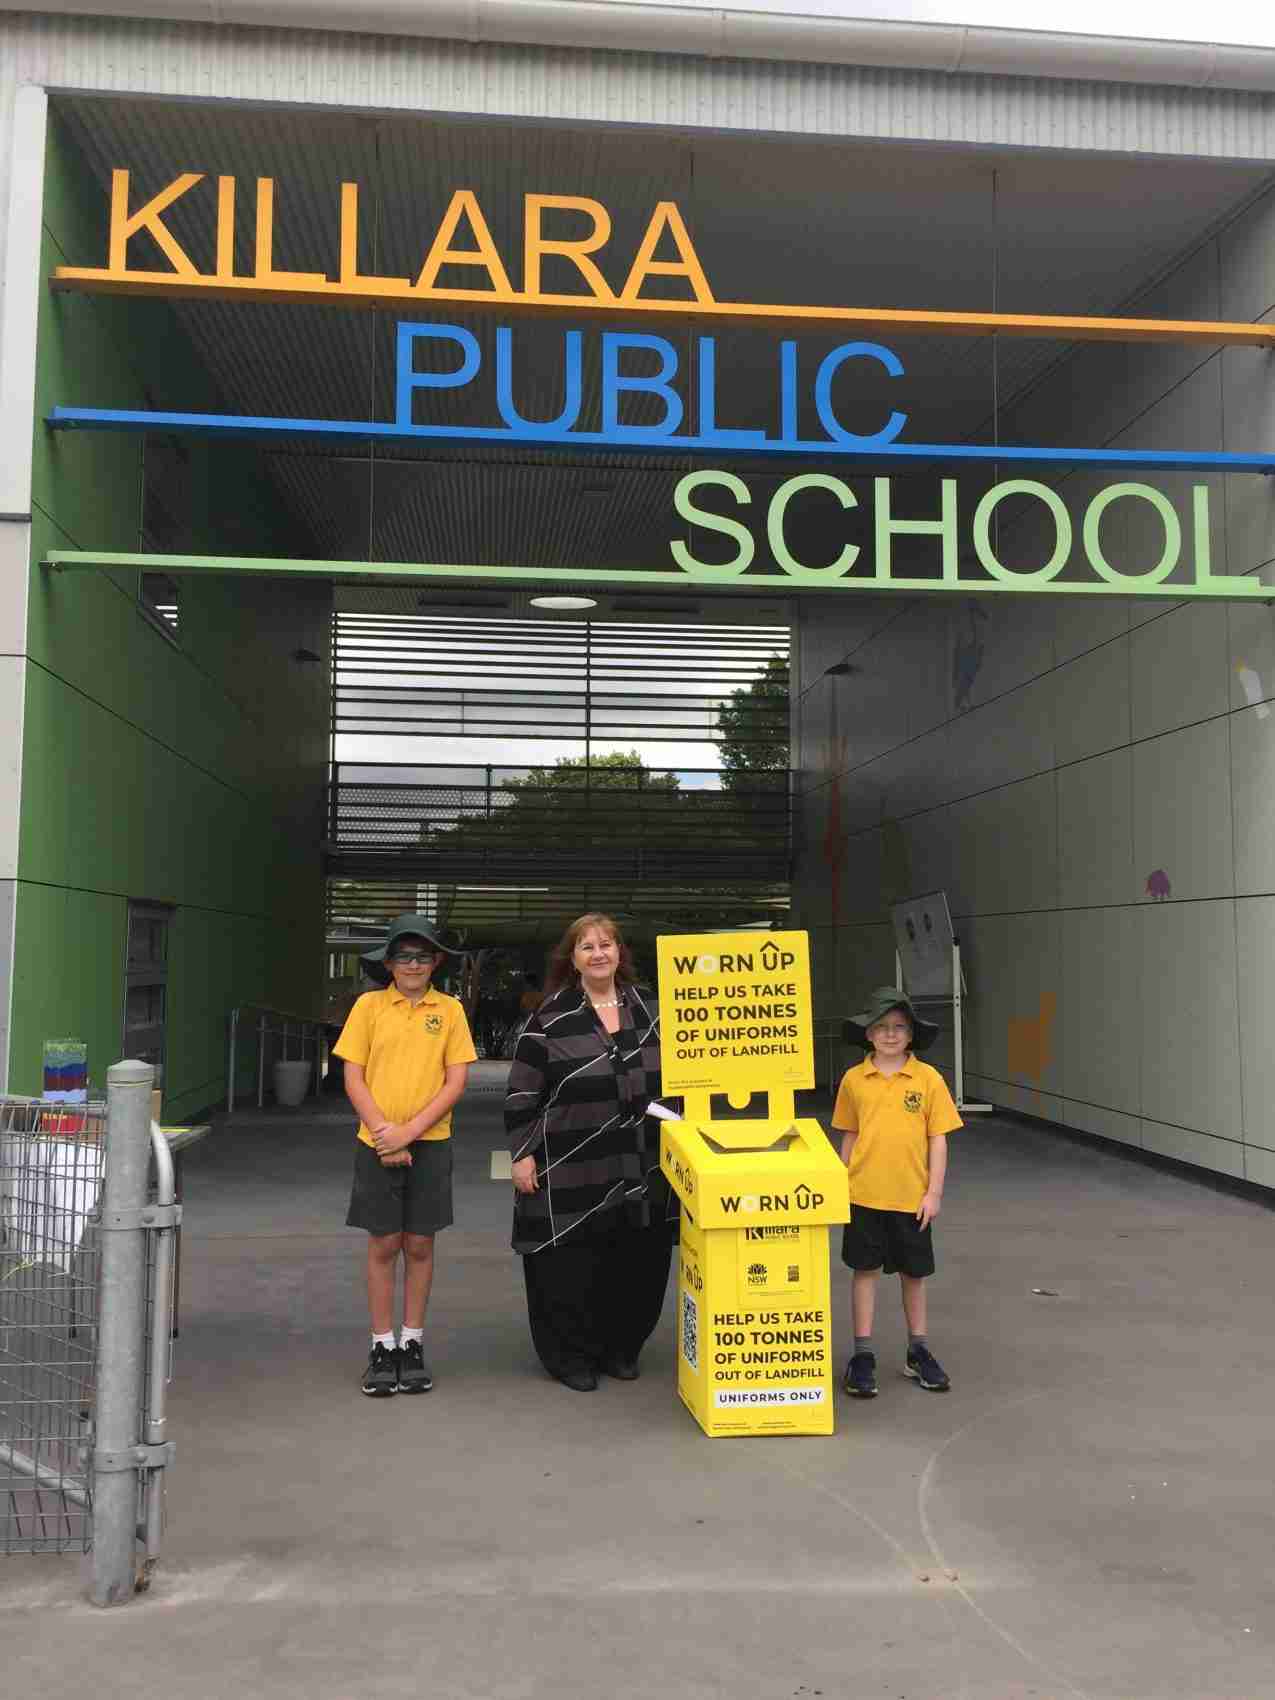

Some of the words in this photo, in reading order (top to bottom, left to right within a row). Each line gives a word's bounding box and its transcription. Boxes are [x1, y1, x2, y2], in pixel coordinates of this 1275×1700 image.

[107, 169, 716, 305] KILLARA
[395, 321, 907, 445] PUBLIC
[670, 470, 1260, 588] SCHOOL
[673, 953, 754, 974] WORN
[762, 950, 795, 971] UP
[674, 987, 719, 1000] HELP
[724, 985, 747, 998] US
[752, 984, 796, 997] TAKE
[675, 1008, 709, 1022] 100
[715, 1003, 797, 1021] TONNES
[676, 1029, 700, 1043] OF
[705, 1024, 798, 1041] UNIFORMS
[676, 1048, 705, 1060] OUT
[709, 1047, 728, 1058] OF
[732, 1044, 798, 1057] LANDFILL
[720, 1195, 789, 1213] WORN
[796, 1192, 825, 1210] UP
[714, 1313, 755, 1325] HELP
[760, 1312, 780, 1324] US
[784, 1311, 824, 1323] TAKE
[715, 1332, 745, 1345] 100
[751, 1329, 824, 1345] TONNES
[714, 1352, 737, 1365] OF
[741, 1349, 825, 1364] UNIFORMS
[715, 1370, 742, 1380] OUT
[745, 1370, 761, 1380] OF
[766, 1368, 824, 1379] LANDFILL
[719, 1393, 785, 1403] UNIFORMS
[790, 1391, 821, 1401] ONLY
